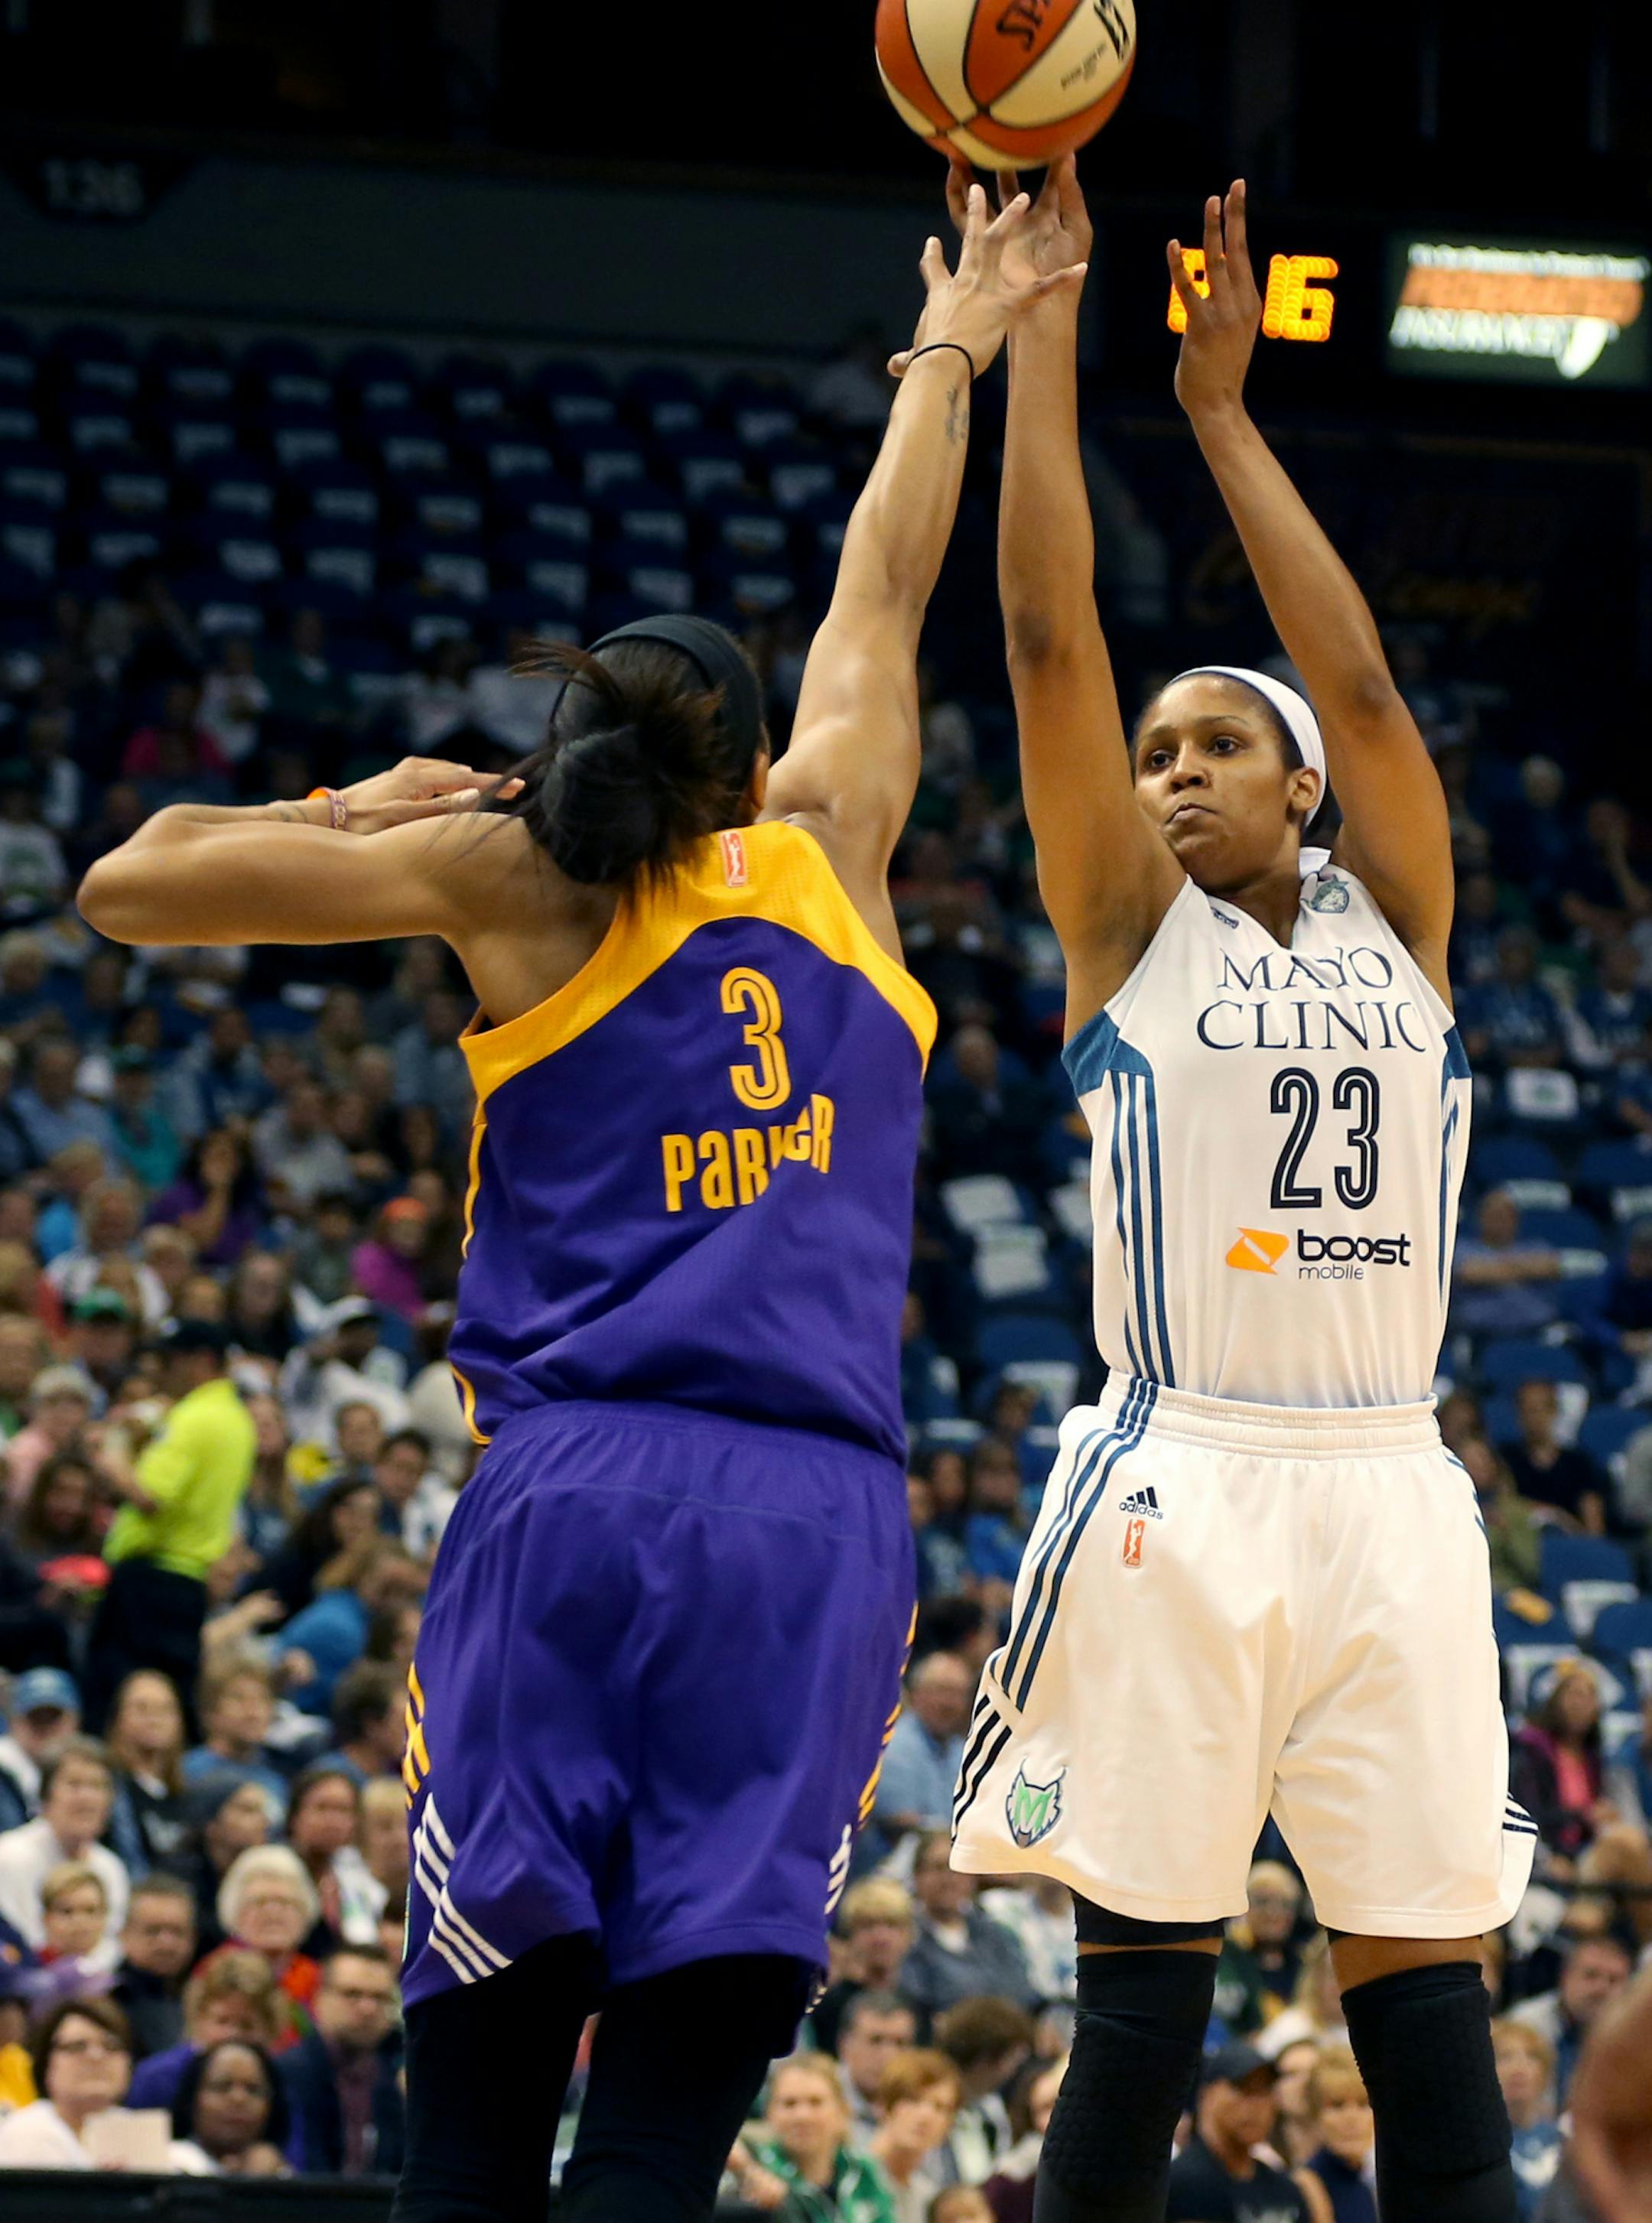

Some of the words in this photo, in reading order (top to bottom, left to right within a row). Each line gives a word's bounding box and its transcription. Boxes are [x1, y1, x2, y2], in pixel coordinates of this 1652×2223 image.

[1217, 947, 1393, 992] MAYO
[720, 967, 792, 1110] 3
[1196, 999, 1426, 1053] CLINIC
[1270, 1067, 1380, 1210] 23
[1297, 1228, 1411, 1267] boost
[1298, 1263, 1364, 1280] mobile
[1118, 1500, 1163, 1520] adidas
